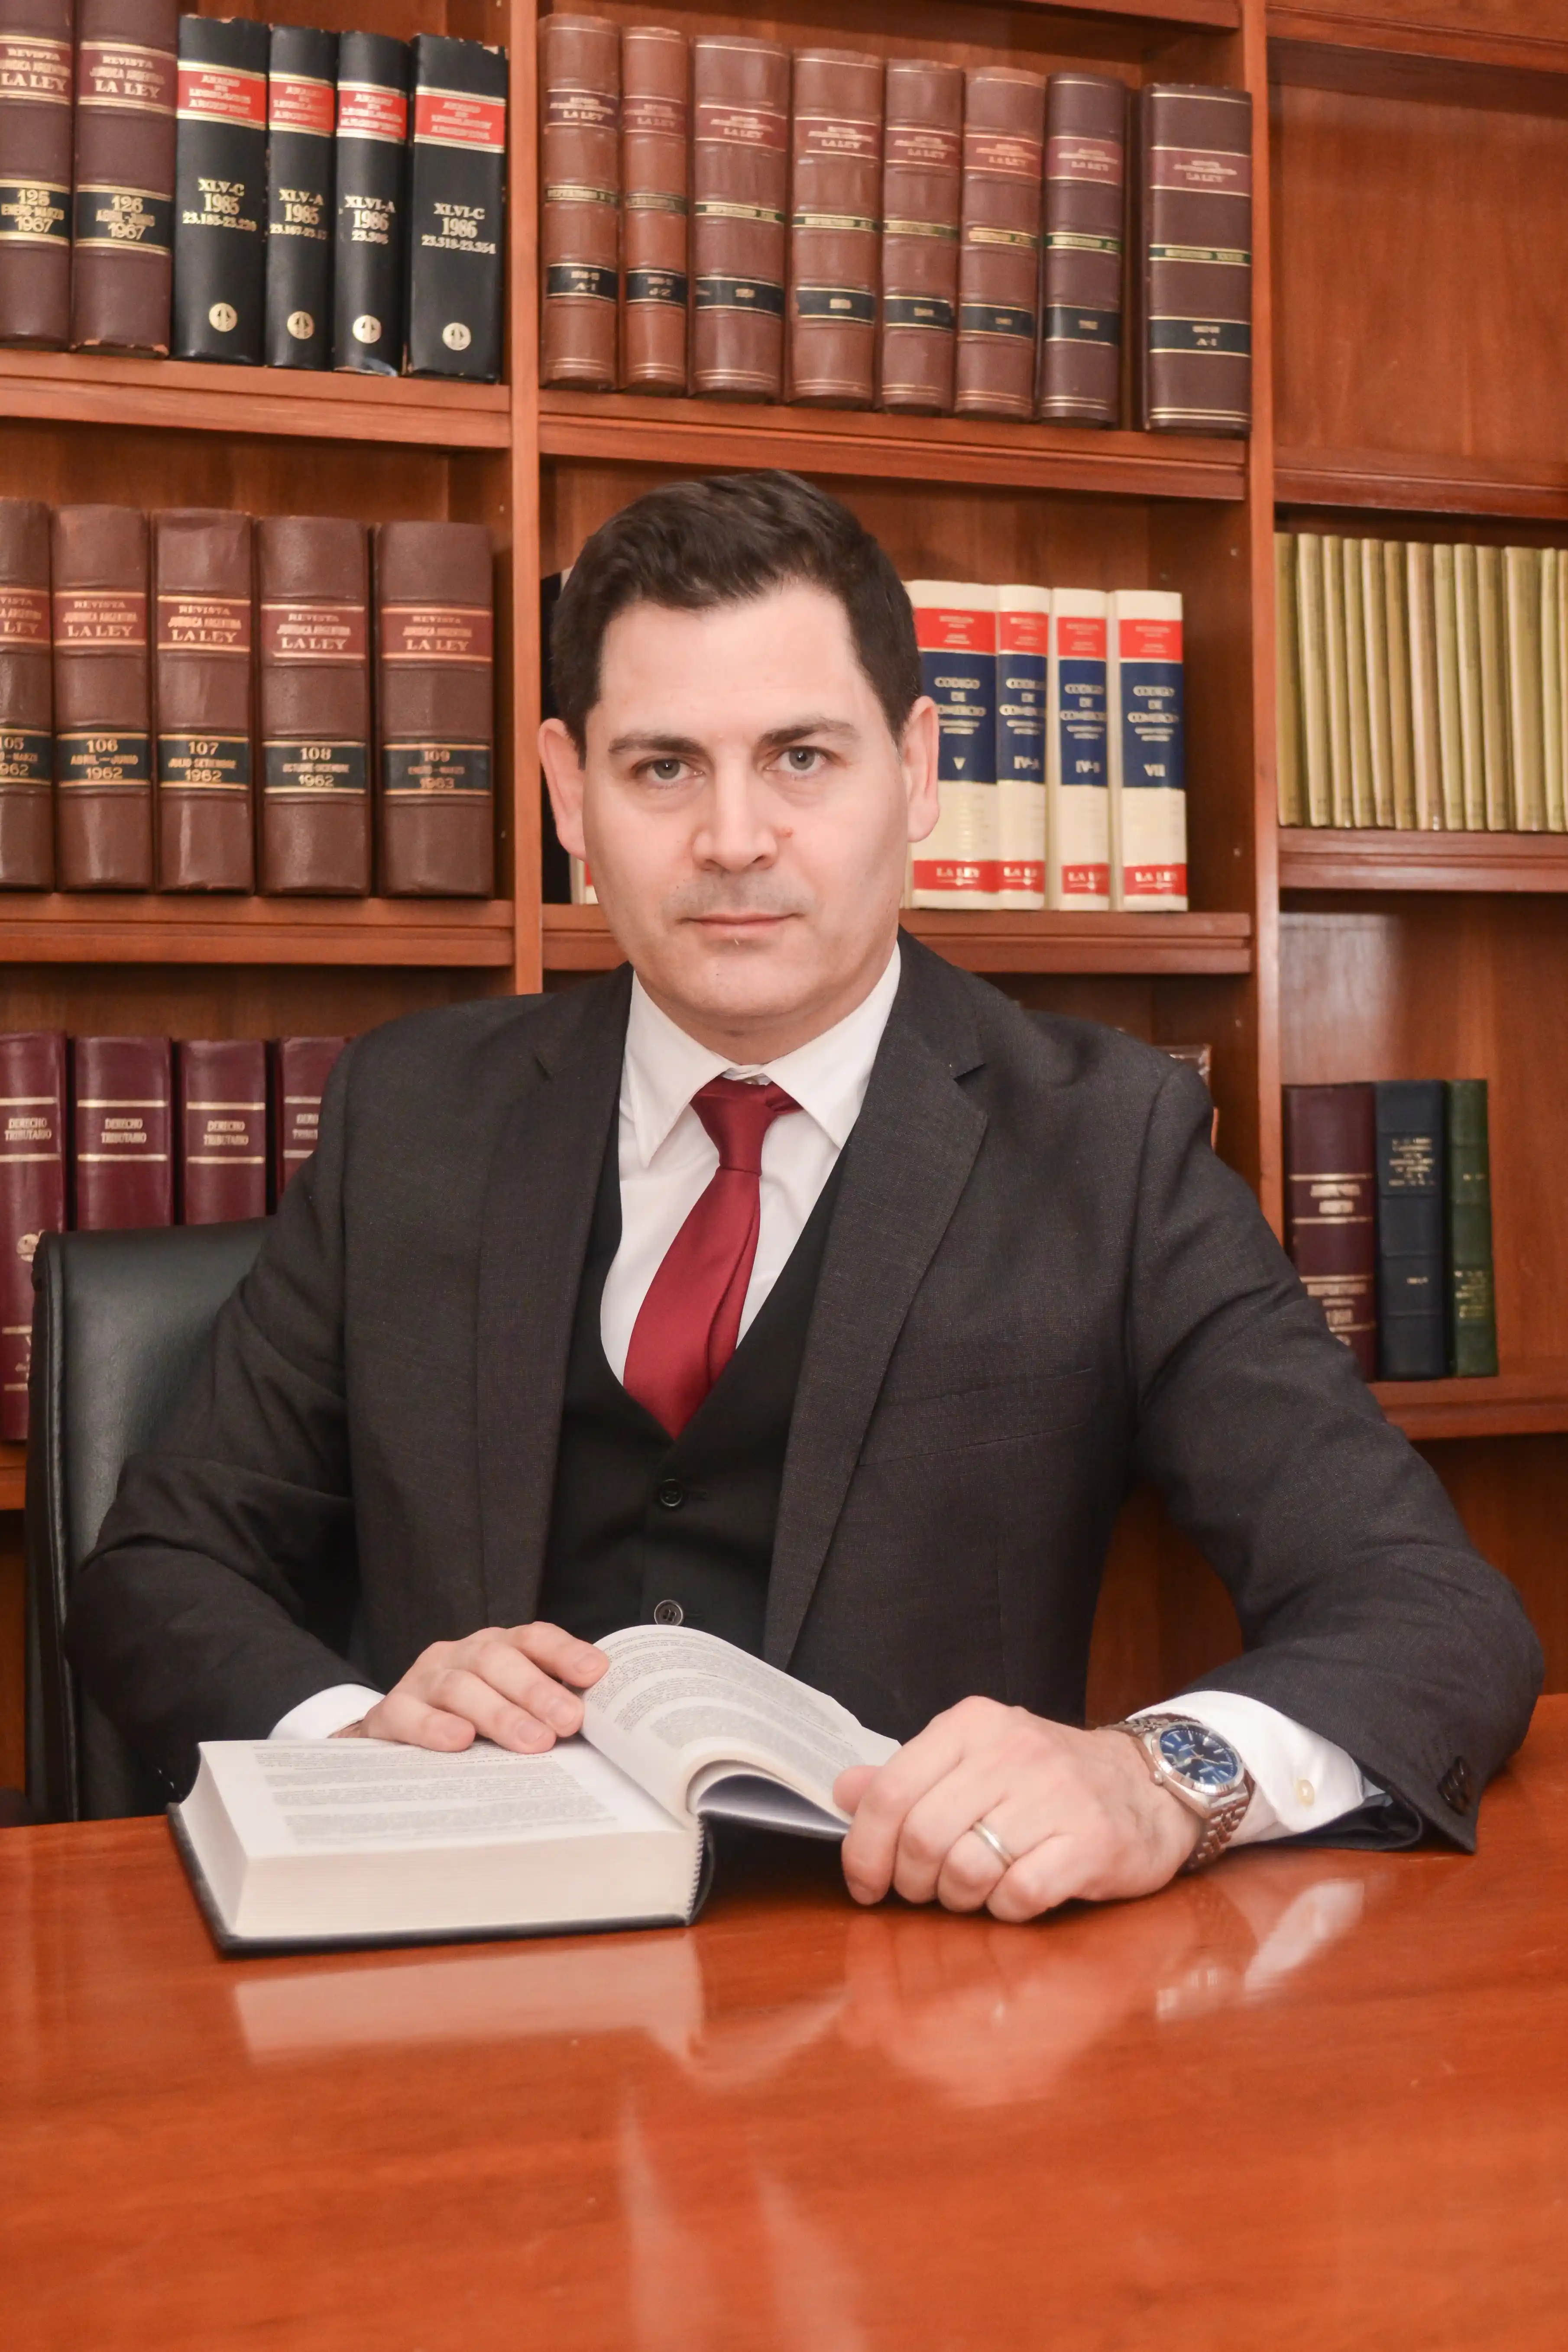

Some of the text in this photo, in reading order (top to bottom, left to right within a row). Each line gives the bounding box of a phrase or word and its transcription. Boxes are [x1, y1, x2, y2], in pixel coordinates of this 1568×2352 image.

[7, 48, 60, 61] REVISTA
[102, 55, 153, 68] REVISTA
[1, 73, 66, 91] LA LEY
[95, 79, 161, 98] LA LEY
[724, 127, 738, 136] LA
[198, 178, 244, 196] XLV-C
[18, 189, 50, 206] 125
[204, 193, 240, 214] 1985
[279, 188, 324, 206] XLV-A
[111, 195, 143, 213] 126
[344, 195, 396, 214] XLVI-A
[285, 203, 320, 224] 1985
[434, 203, 485, 220] XLVI-C
[14, 217, 54, 233] 1967
[353, 210, 389, 231] 1986
[108, 223, 146, 240] 1967
[441, 217, 477, 239] 1986
[74, 600, 126, 609] REVISTA
[178, 605, 230, 615] REVISTA
[288, 613, 339, 622] REVISTA
[3, 621, 38, 634] LEY
[68, 625, 133, 637] LA LEY
[172, 630, 237, 643] LA LEY
[281, 637, 347, 650] LA LEY
[405, 639, 470, 652] LA LEY
[87, 739, 118, 753] 106
[188, 741, 218, 755] 107
[300, 747, 331, 761] 108
[423, 750, 450, 762] 109
[0, 763, 29, 775] 962
[953, 757, 965, 770] V
[86, 767, 123, 780] 1962
[185, 769, 222, 783] 1962
[298, 774, 334, 787] 1962
[936, 867, 953, 877] LA
[1004, 867, 1021, 877] LA
[1068, 872, 1085, 882] LA
[1134, 871, 1153, 882] LA
[8, 1117, 47, 1129] DERECHO
[5, 1128, 52, 1141] TRIBUTARIO
